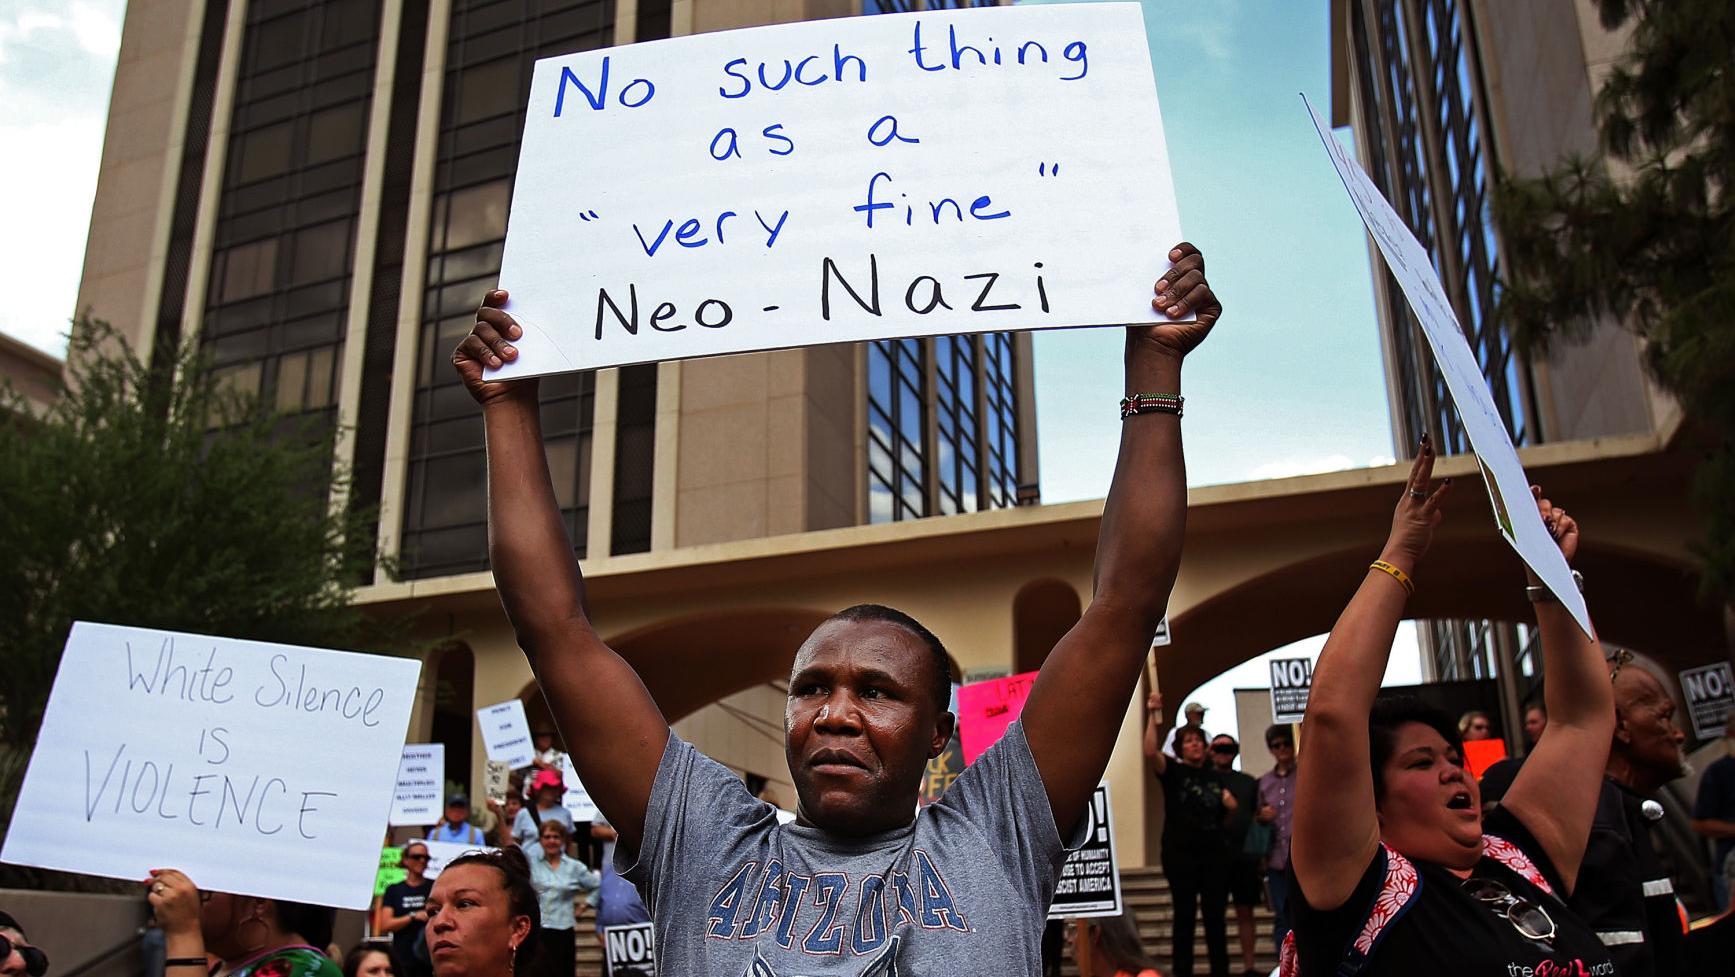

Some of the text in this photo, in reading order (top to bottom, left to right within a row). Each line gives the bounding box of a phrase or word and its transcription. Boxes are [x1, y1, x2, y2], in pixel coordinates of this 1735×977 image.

[554, 20, 1089, 118] No such thing
[709, 114, 920, 161] as a
[126, 637, 384, 728] White Silence
[1272, 659, 1312, 687] NO!
[1687, 669, 1731, 701] NO!
[85, 743, 338, 840] VIOLENCE
[704, 848, 971, 957] ARIZONA
[610, 929, 653, 963] NO!
[1507, 962, 1534, 977] the
